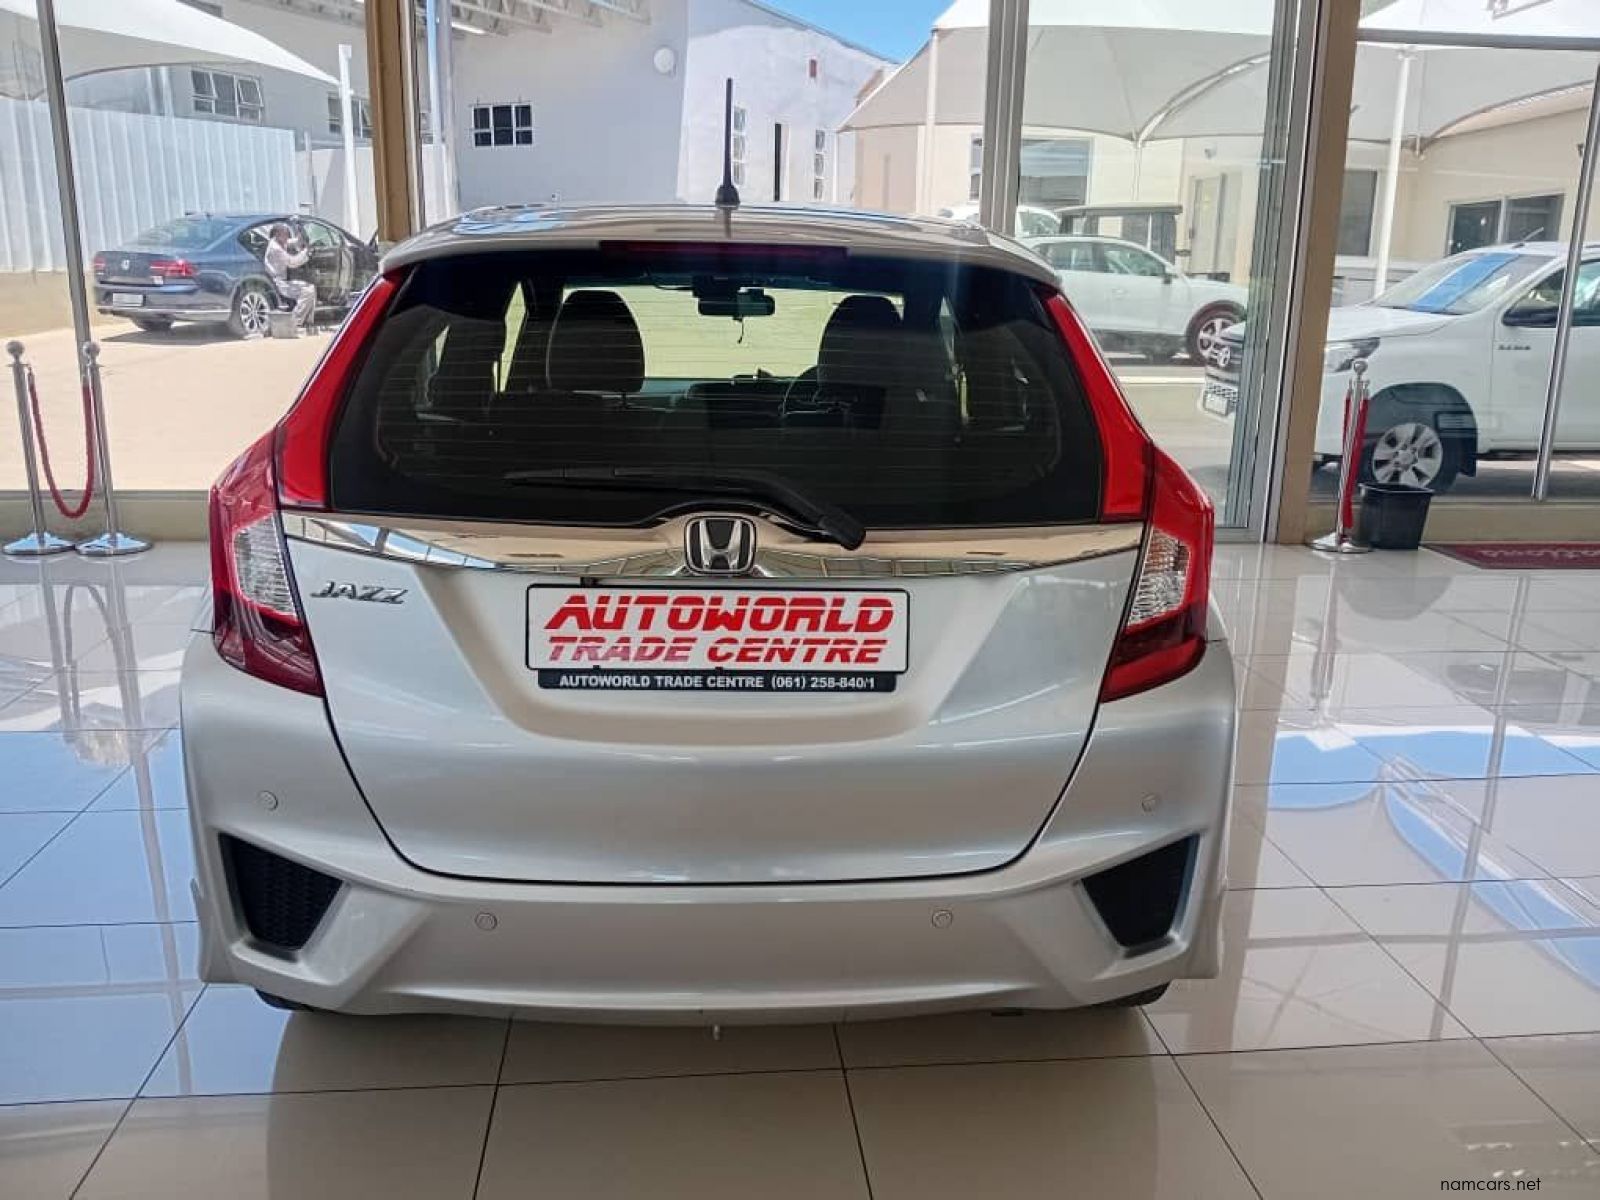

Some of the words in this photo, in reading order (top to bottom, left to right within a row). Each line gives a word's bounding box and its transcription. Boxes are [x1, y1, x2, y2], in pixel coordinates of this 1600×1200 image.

[310, 581, 408, 604] JAZZ
[544, 595, 893, 632] AUTOWORLD
[548, 636, 698, 661] TRADE
[707, 637, 887, 663] CENTRE
[559, 675, 650, 688] AUTOWORLD
[654, 675, 703, 688] TRADE
[707, 675, 764, 688] CENTRE
[771, 674, 806, 690] (061)
